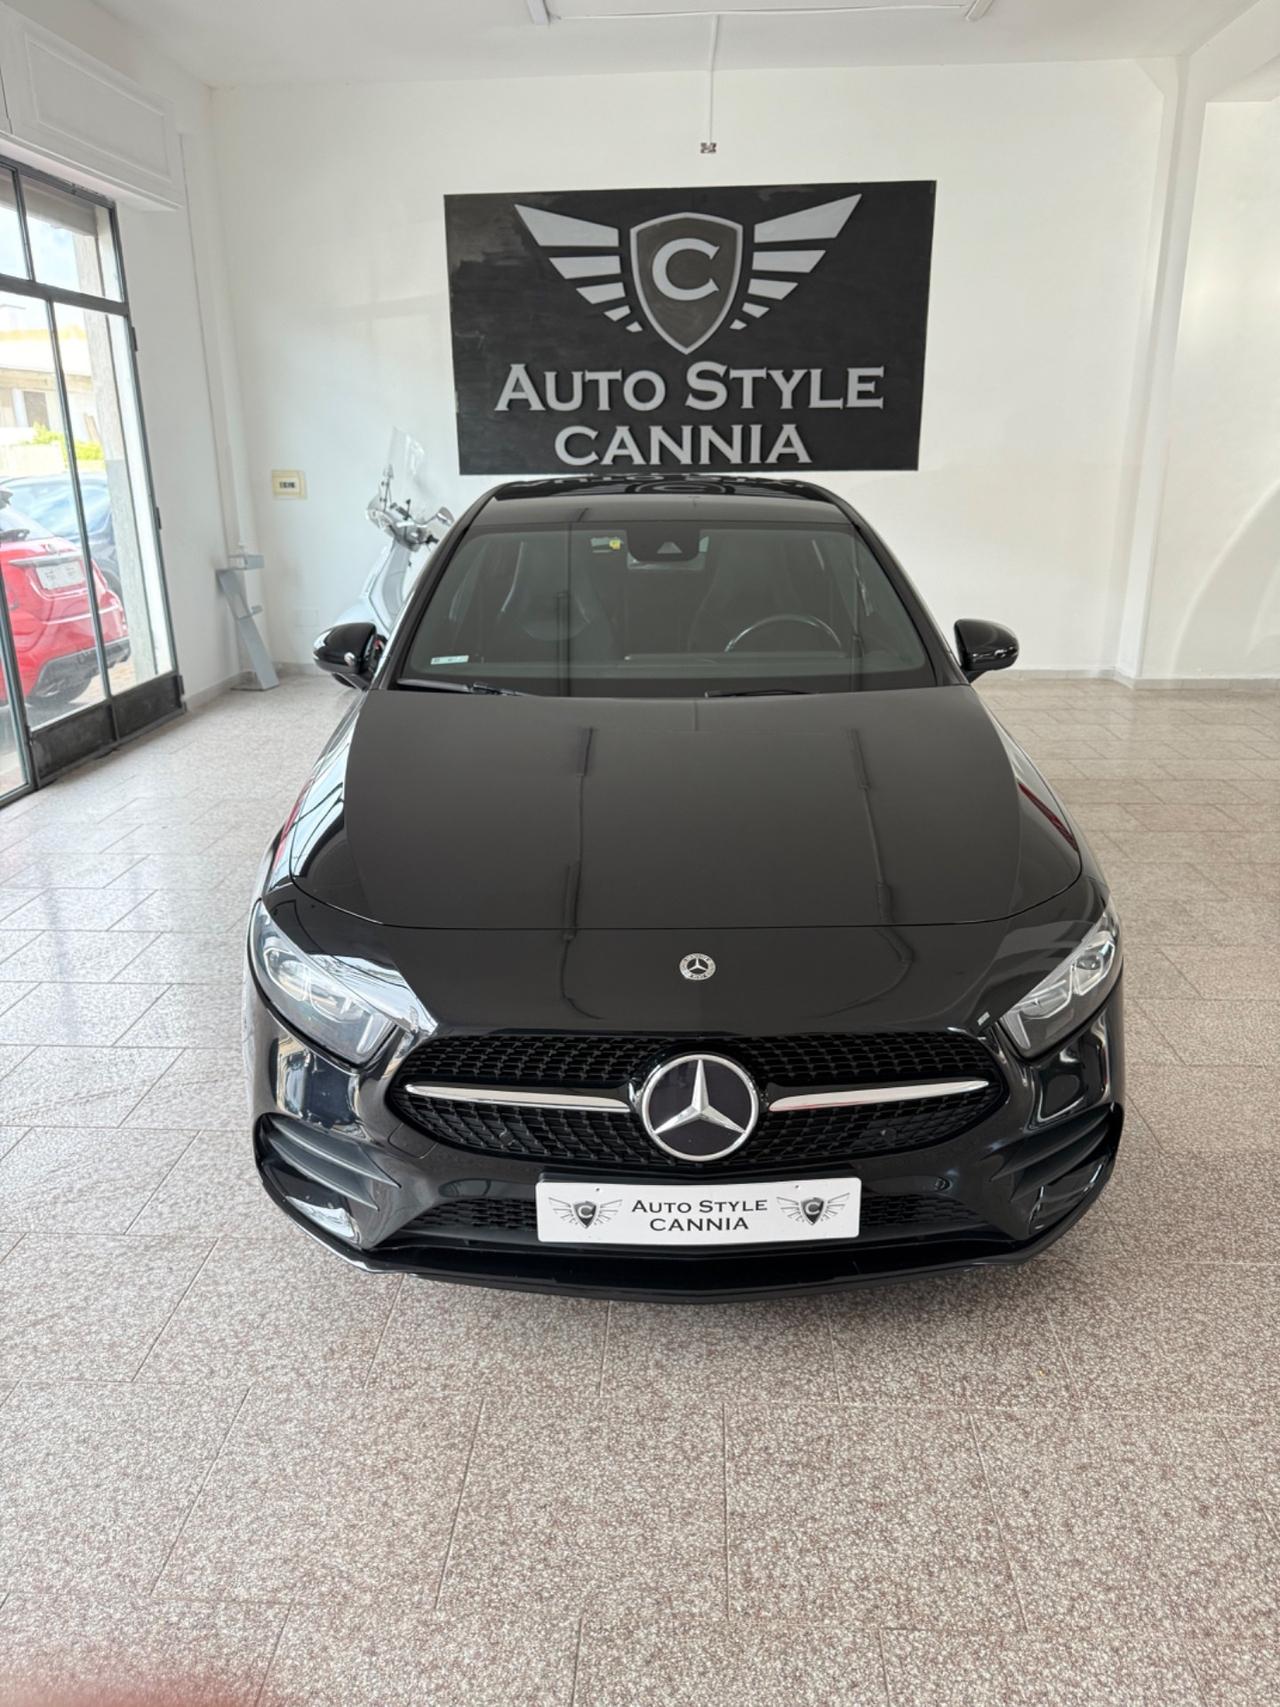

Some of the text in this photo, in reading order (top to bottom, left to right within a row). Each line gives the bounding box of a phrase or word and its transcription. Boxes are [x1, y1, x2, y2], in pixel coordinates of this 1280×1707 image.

[652, 238, 720, 301] C
[494, 361, 885, 412] AUTO STYLE
[554, 423, 813, 466] CANNIA
[631, 1199, 768, 1214] AUTO STYLE
[649, 1216, 749, 1232] CANNIA
